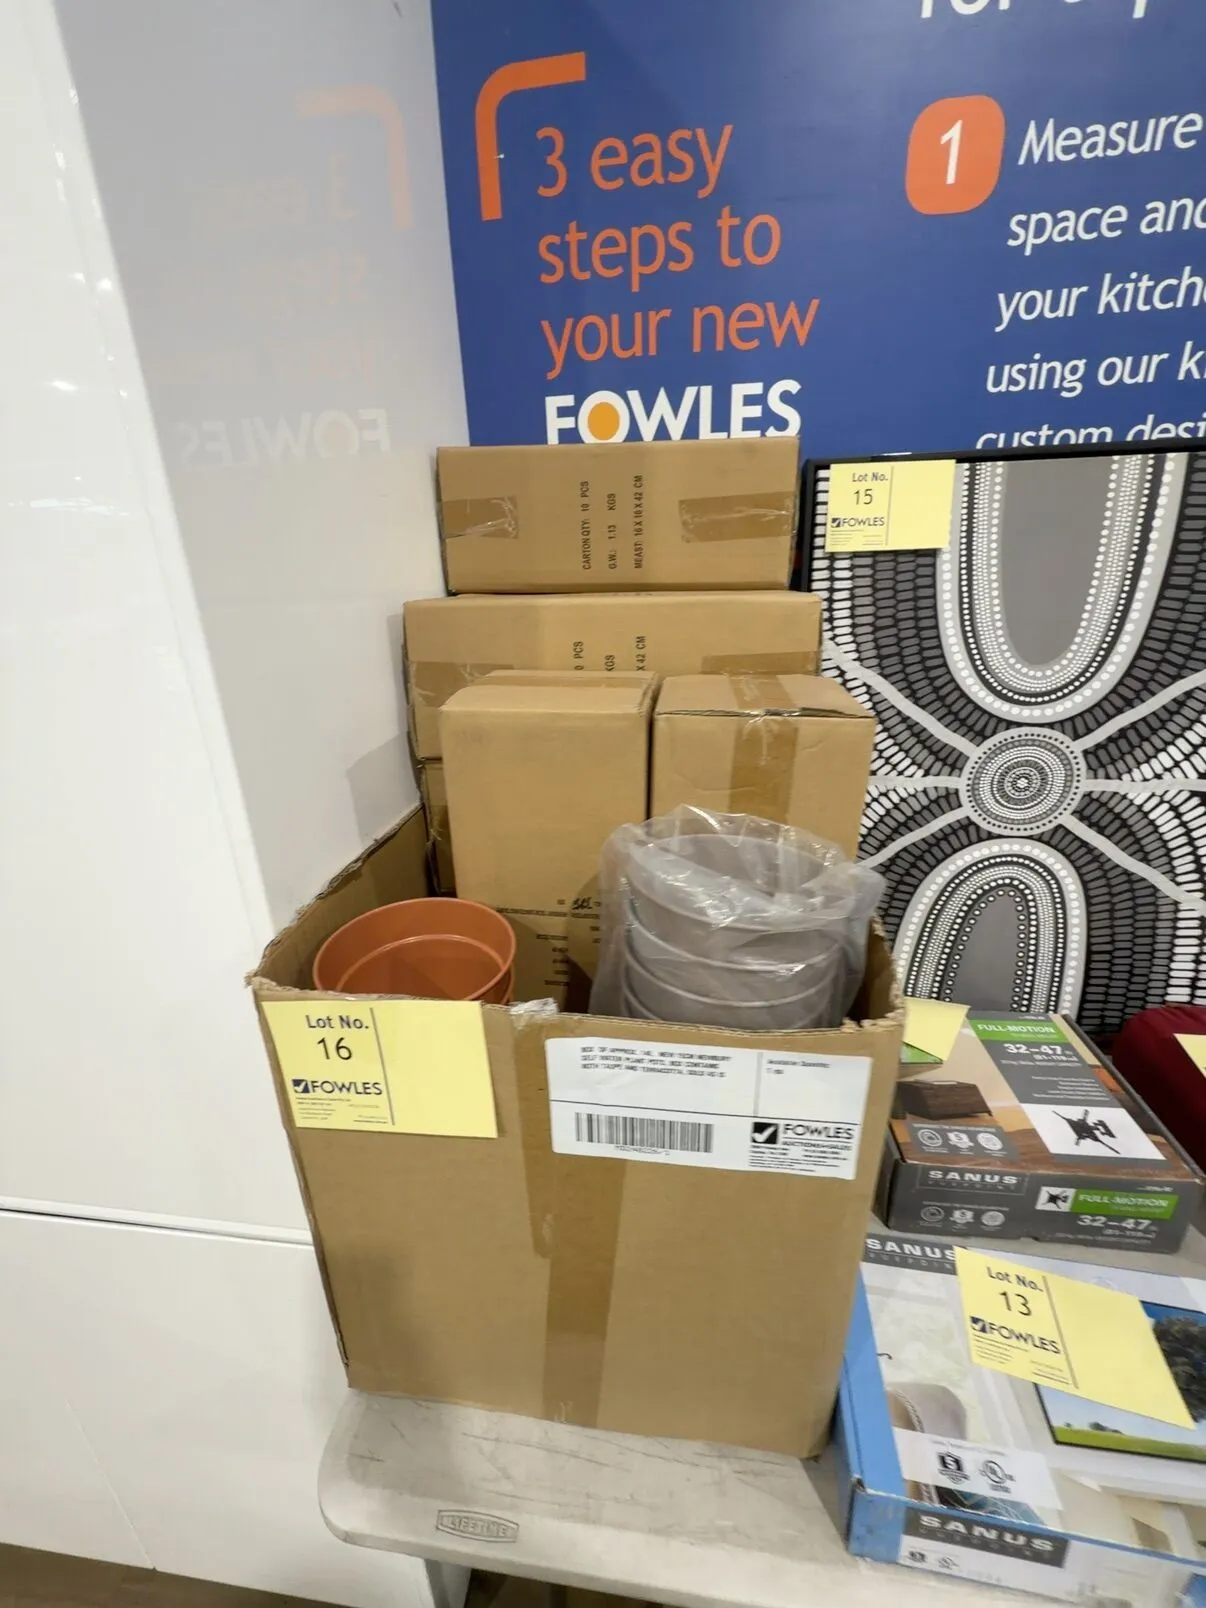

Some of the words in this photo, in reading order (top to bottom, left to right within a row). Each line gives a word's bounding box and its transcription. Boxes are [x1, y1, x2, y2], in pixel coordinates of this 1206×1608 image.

[938, 118, 964, 186] 1
[1017, 112, 1204, 166] Measure
[536, 125, 568, 198] 3
[590, 124, 734, 200] easy
[1006, 204, 1128, 256] space
[538, 220, 695, 292] steps
[716, 205, 781, 268] to
[994, 283, 1090, 333] your
[540, 308, 672, 381] your
[692, 298, 821, 353] new
[985, 352, 1087, 398] using
[1097, 351, 1169, 387] our
[544, 378, 802, 445] FOWLES
[975, 423, 1115, 449] custom
[579, 480, 590, 498] PCS
[633, 474, 644, 489] CM
[852, 472, 868, 483] Lot
[871, 471, 889, 482] No.
[606, 493, 617, 511] KGS
[853, 488, 874, 506] 15
[841, 516, 886, 527] FOWLES
[572, 641, 584, 660] PCS
[635, 635, 647, 650] CM
[305, 1014, 335, 1029] Lot
[338, 1014, 370, 1030] No.
[316, 1036, 353, 1061] 16
[311, 1080, 383, 1096] FOWLES
[782, 1123, 856, 1140] FOWLES
[927, 1170, 1019, 1184] SANUS
[986, 1266, 1012, 1284] Lot
[1015, 1274, 1045, 1293] No.
[998, 1290, 1032, 1317] 13
[987, 1322, 1062, 1355] FOWLES
[918, 1514, 1055, 1552] SANUS
